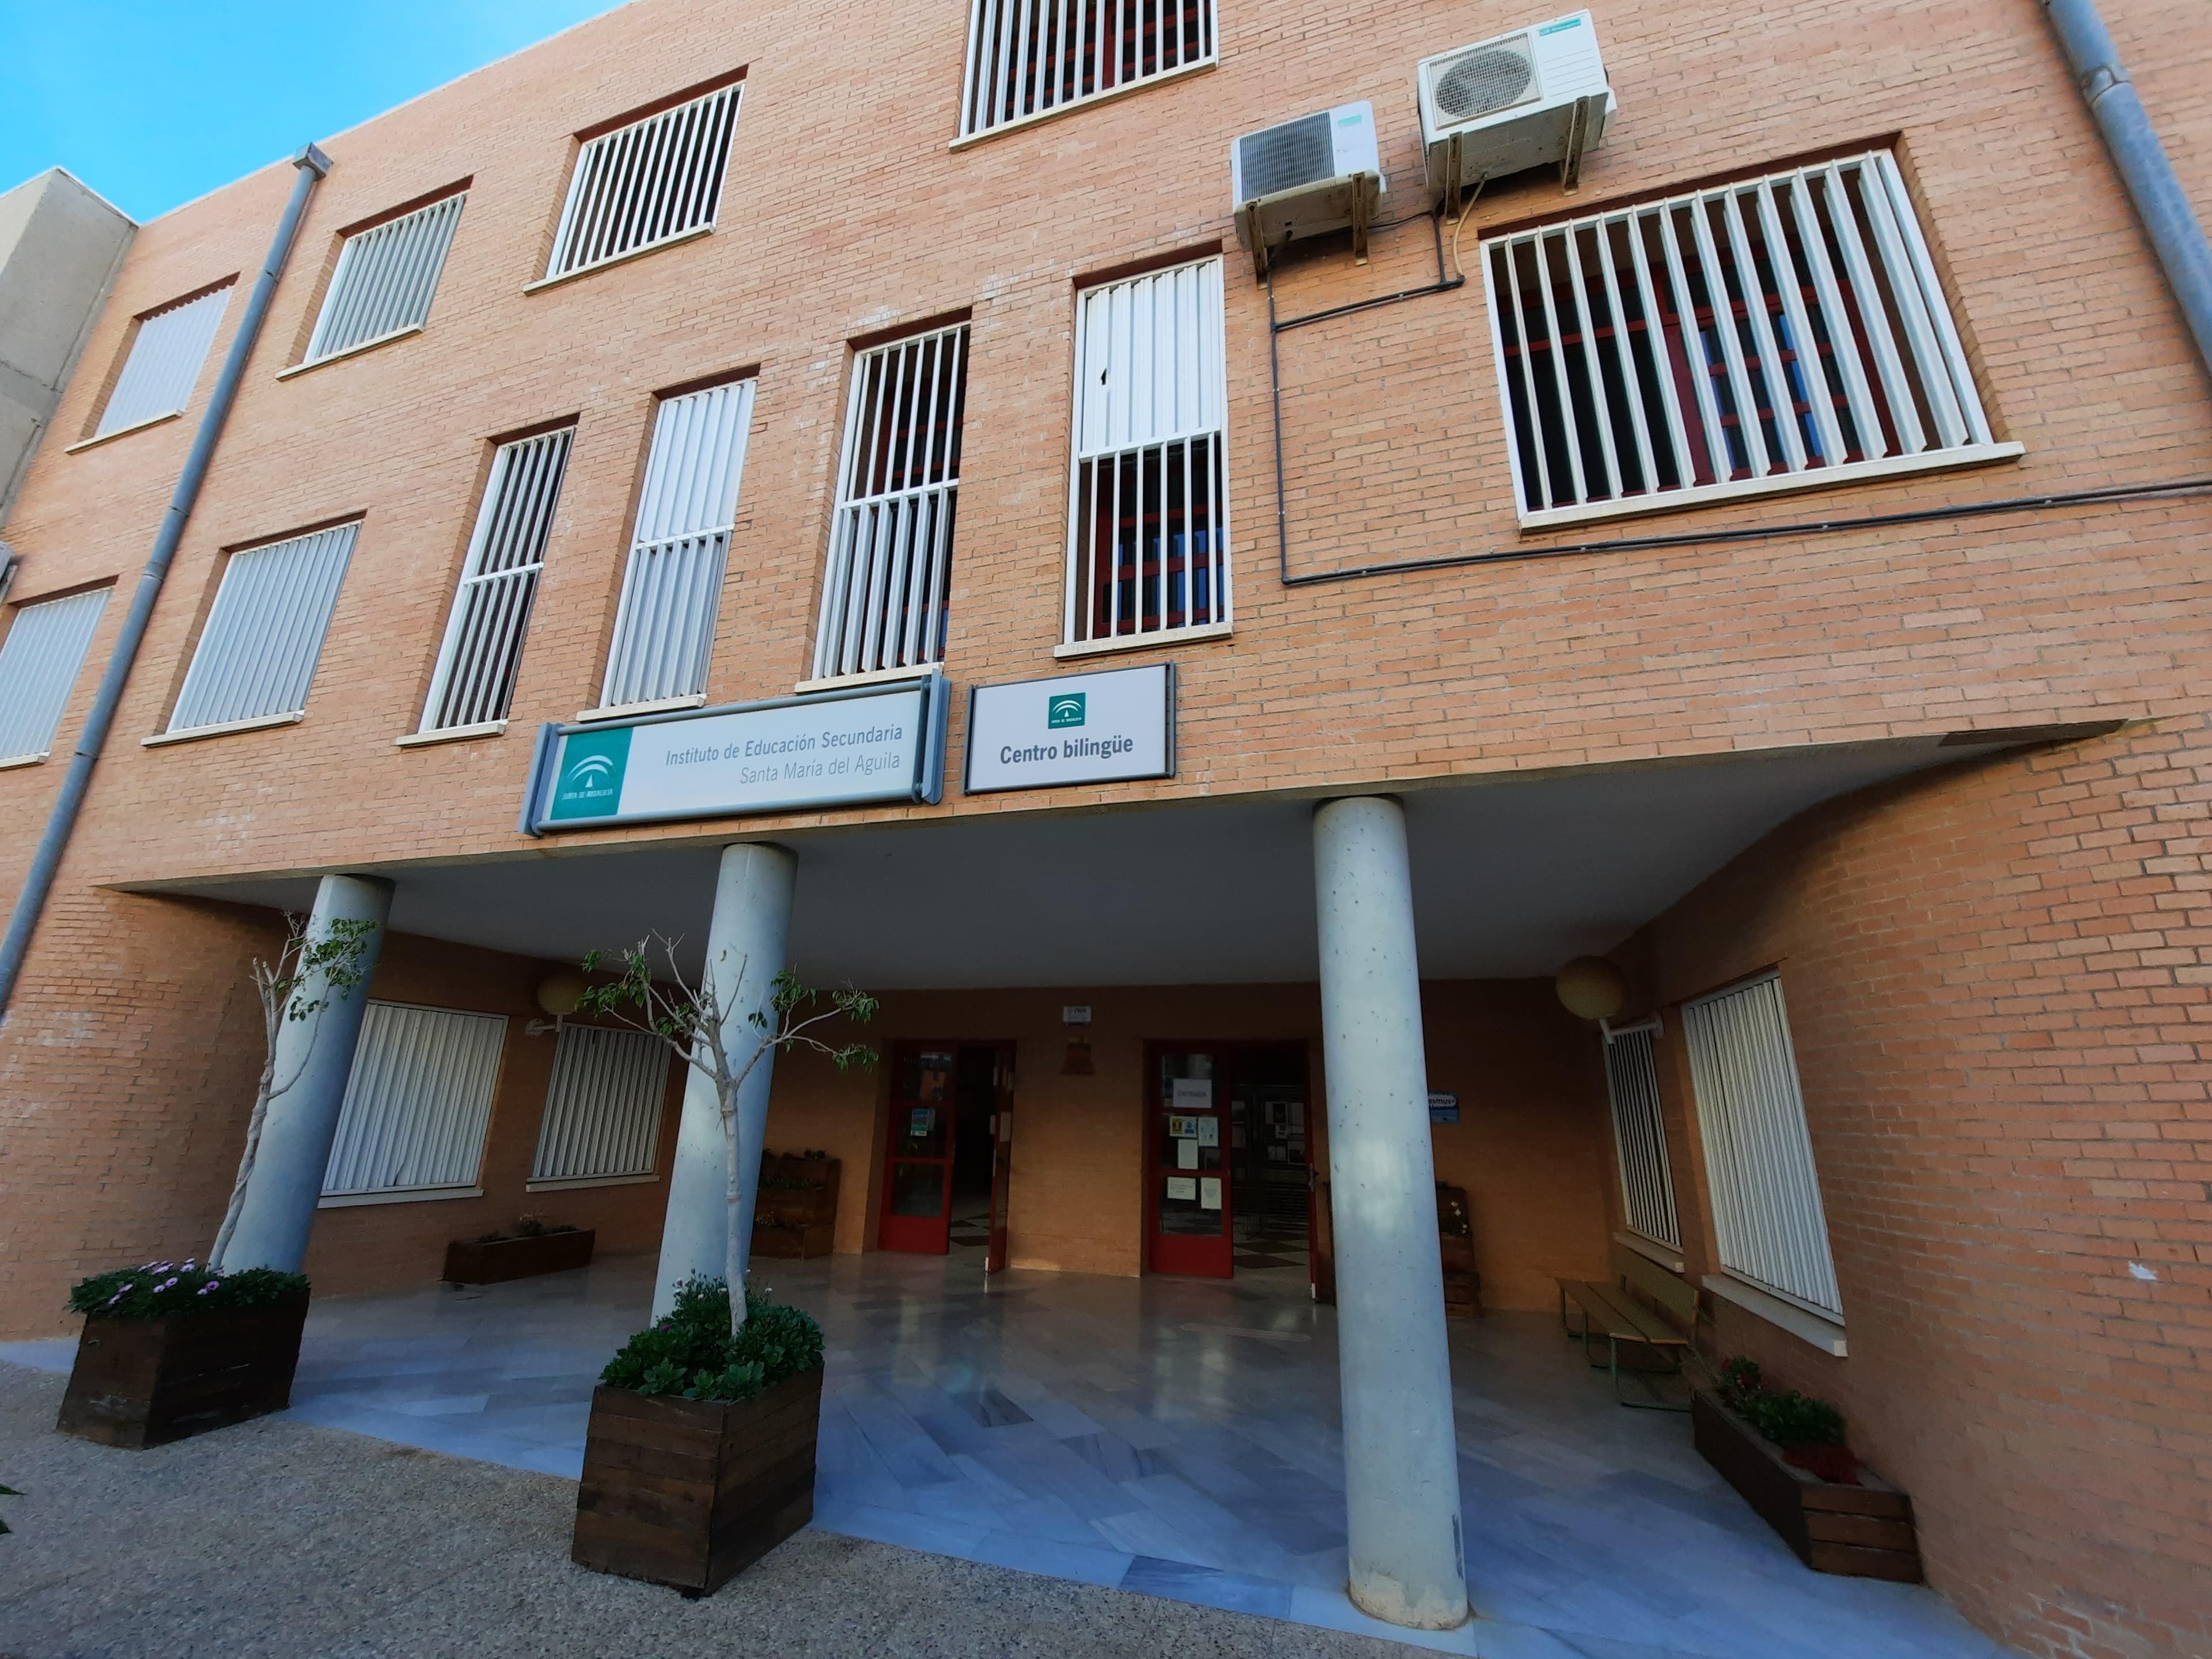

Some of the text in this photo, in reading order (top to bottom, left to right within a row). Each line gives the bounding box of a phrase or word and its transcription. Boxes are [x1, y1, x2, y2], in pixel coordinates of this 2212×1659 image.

[666, 724, 902, 766] Instituto de Educación Secundaria
[1000, 735, 1134, 764] Centro bilingüe
[740, 752, 900, 783] Santa María del Aguila
